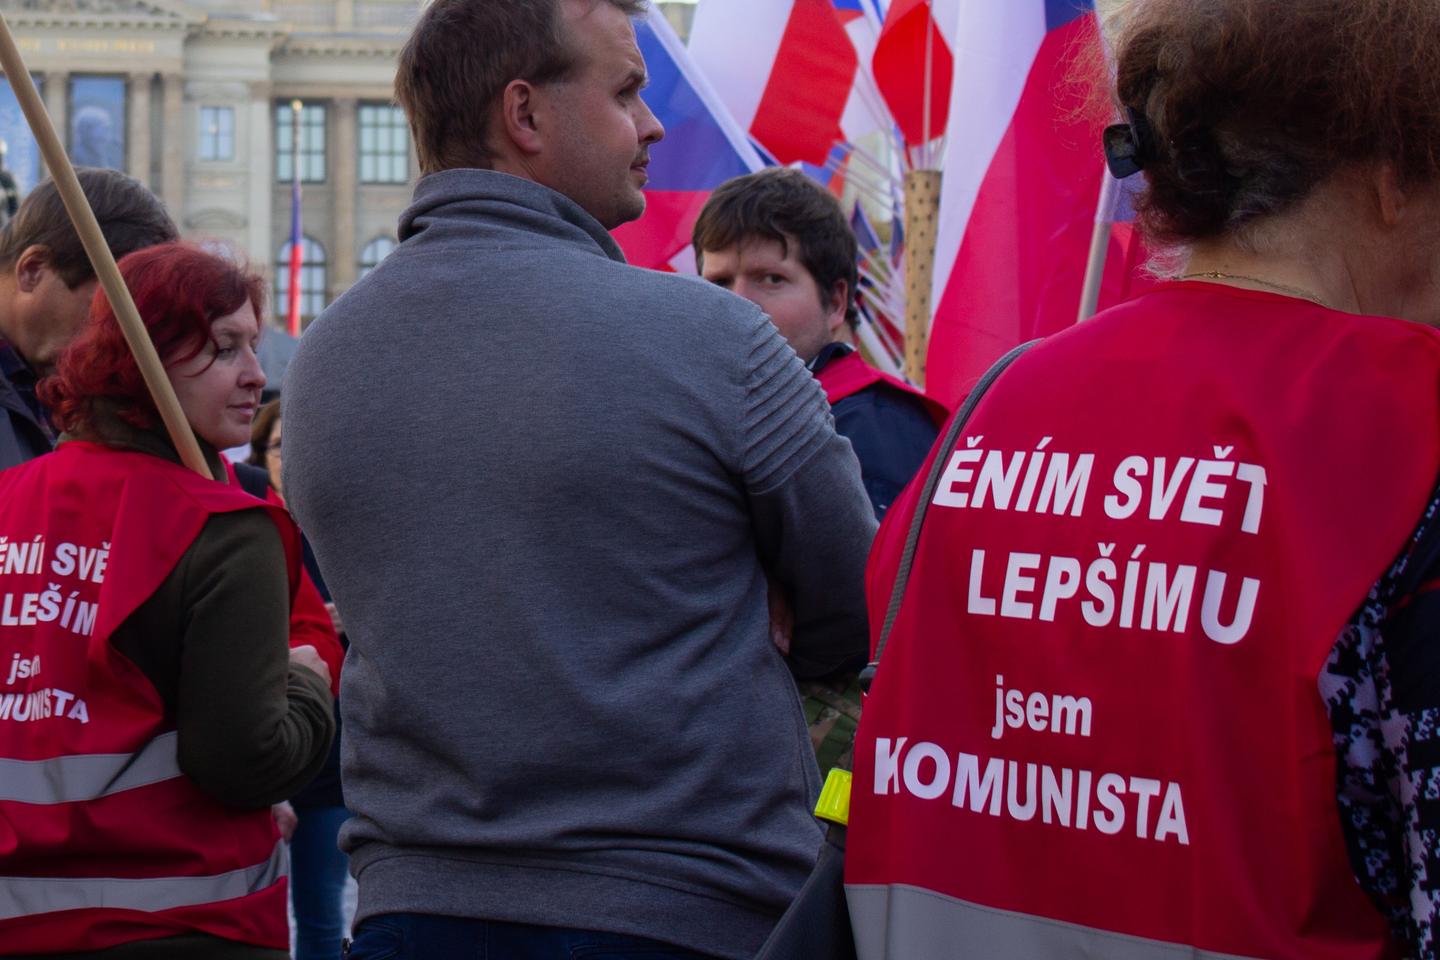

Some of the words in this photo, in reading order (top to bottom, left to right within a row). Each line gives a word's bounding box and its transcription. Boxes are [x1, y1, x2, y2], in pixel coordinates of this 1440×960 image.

[931, 435, 1096, 518] ĚNÍM
[1103, 445, 1268, 535] SVĚT
[50, 541, 112, 584] SVĚ
[967, 542, 1261, 645] LEPŠÍMU
[990, 674, 1093, 740] jsem
[873, 736, 1190, 846] KOMUNISTA
